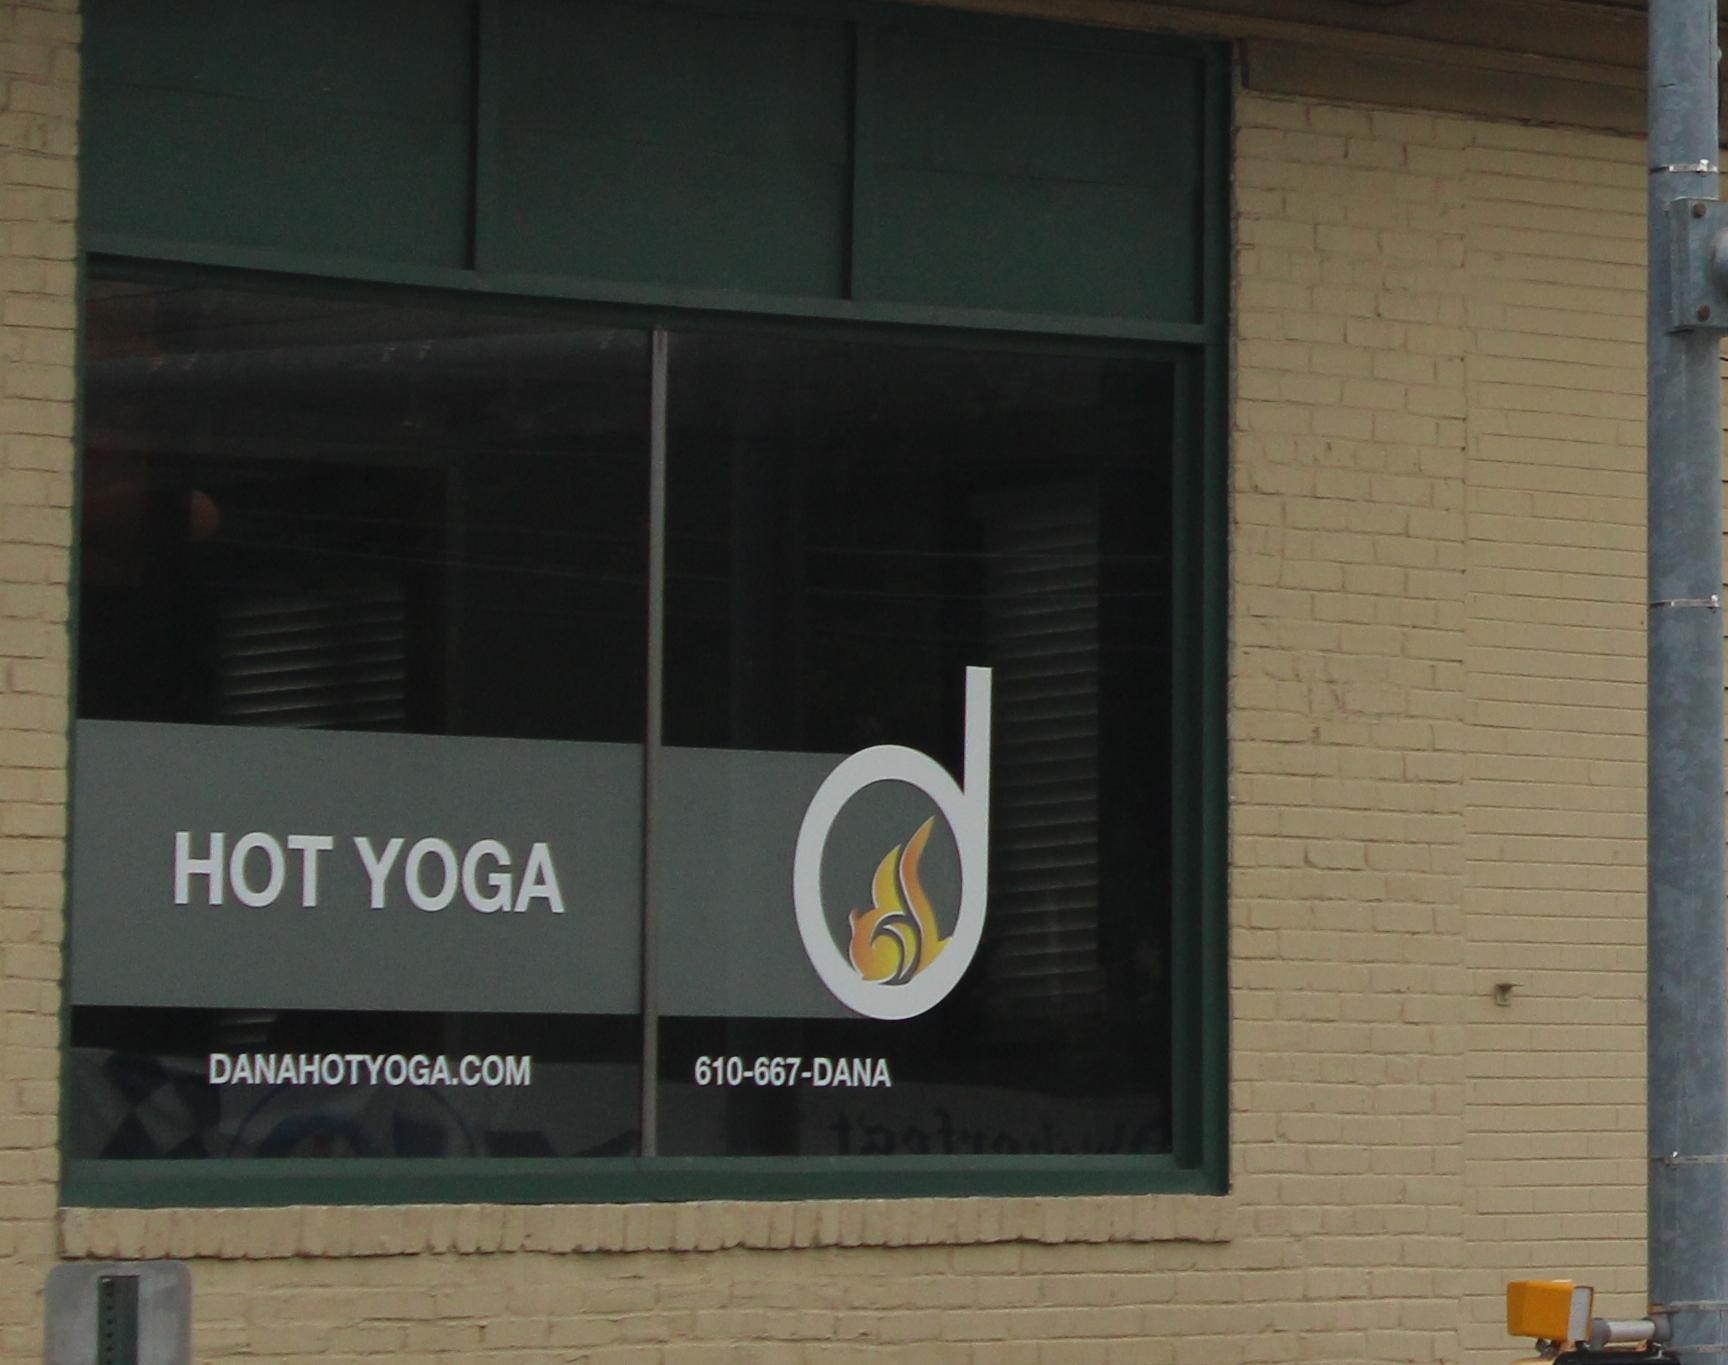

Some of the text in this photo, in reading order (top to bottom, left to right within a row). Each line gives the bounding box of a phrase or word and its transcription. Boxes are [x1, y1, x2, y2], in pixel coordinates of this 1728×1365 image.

[174, 831, 565, 914] HOT YOGA
[210, 1053, 530, 1087] DANAHOTYOGA.COM
[694, 1056, 891, 1087] 610-667-DANA
